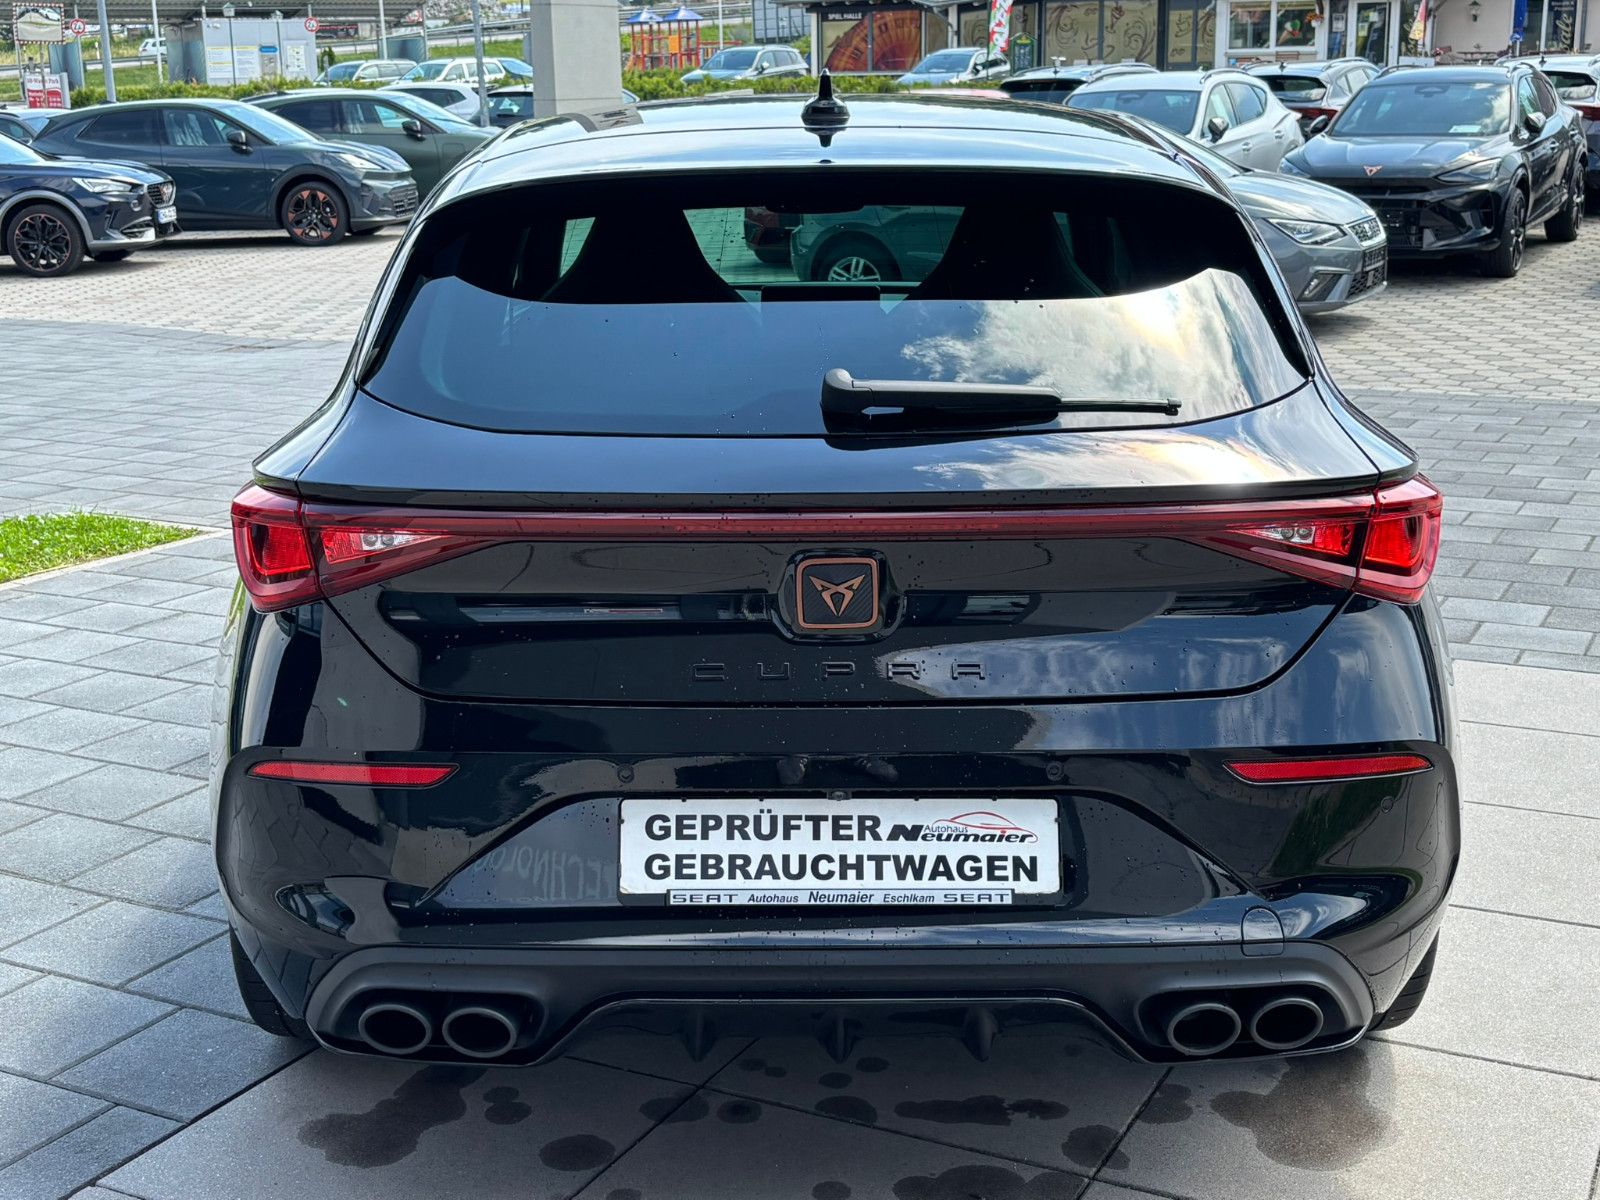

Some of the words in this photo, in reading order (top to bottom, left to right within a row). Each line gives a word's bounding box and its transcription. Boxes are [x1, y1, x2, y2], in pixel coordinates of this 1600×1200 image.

[692, 661, 986, 681] CUPRA
[645, 808, 882, 841] GEPRÜFTER
[886, 824, 1034, 842] Neumaier
[924, 824, 968, 833] Autohaus
[644, 853, 1038, 882] GEBRAUCHTWAGEN
[672, 893, 739, 904] SEAT
[747, 893, 799, 904] Autohaus
[808, 890, 875, 904] Neumaier
[883, 893, 935, 904] Eschlkam
[943, 893, 1010, 903] SEAT
